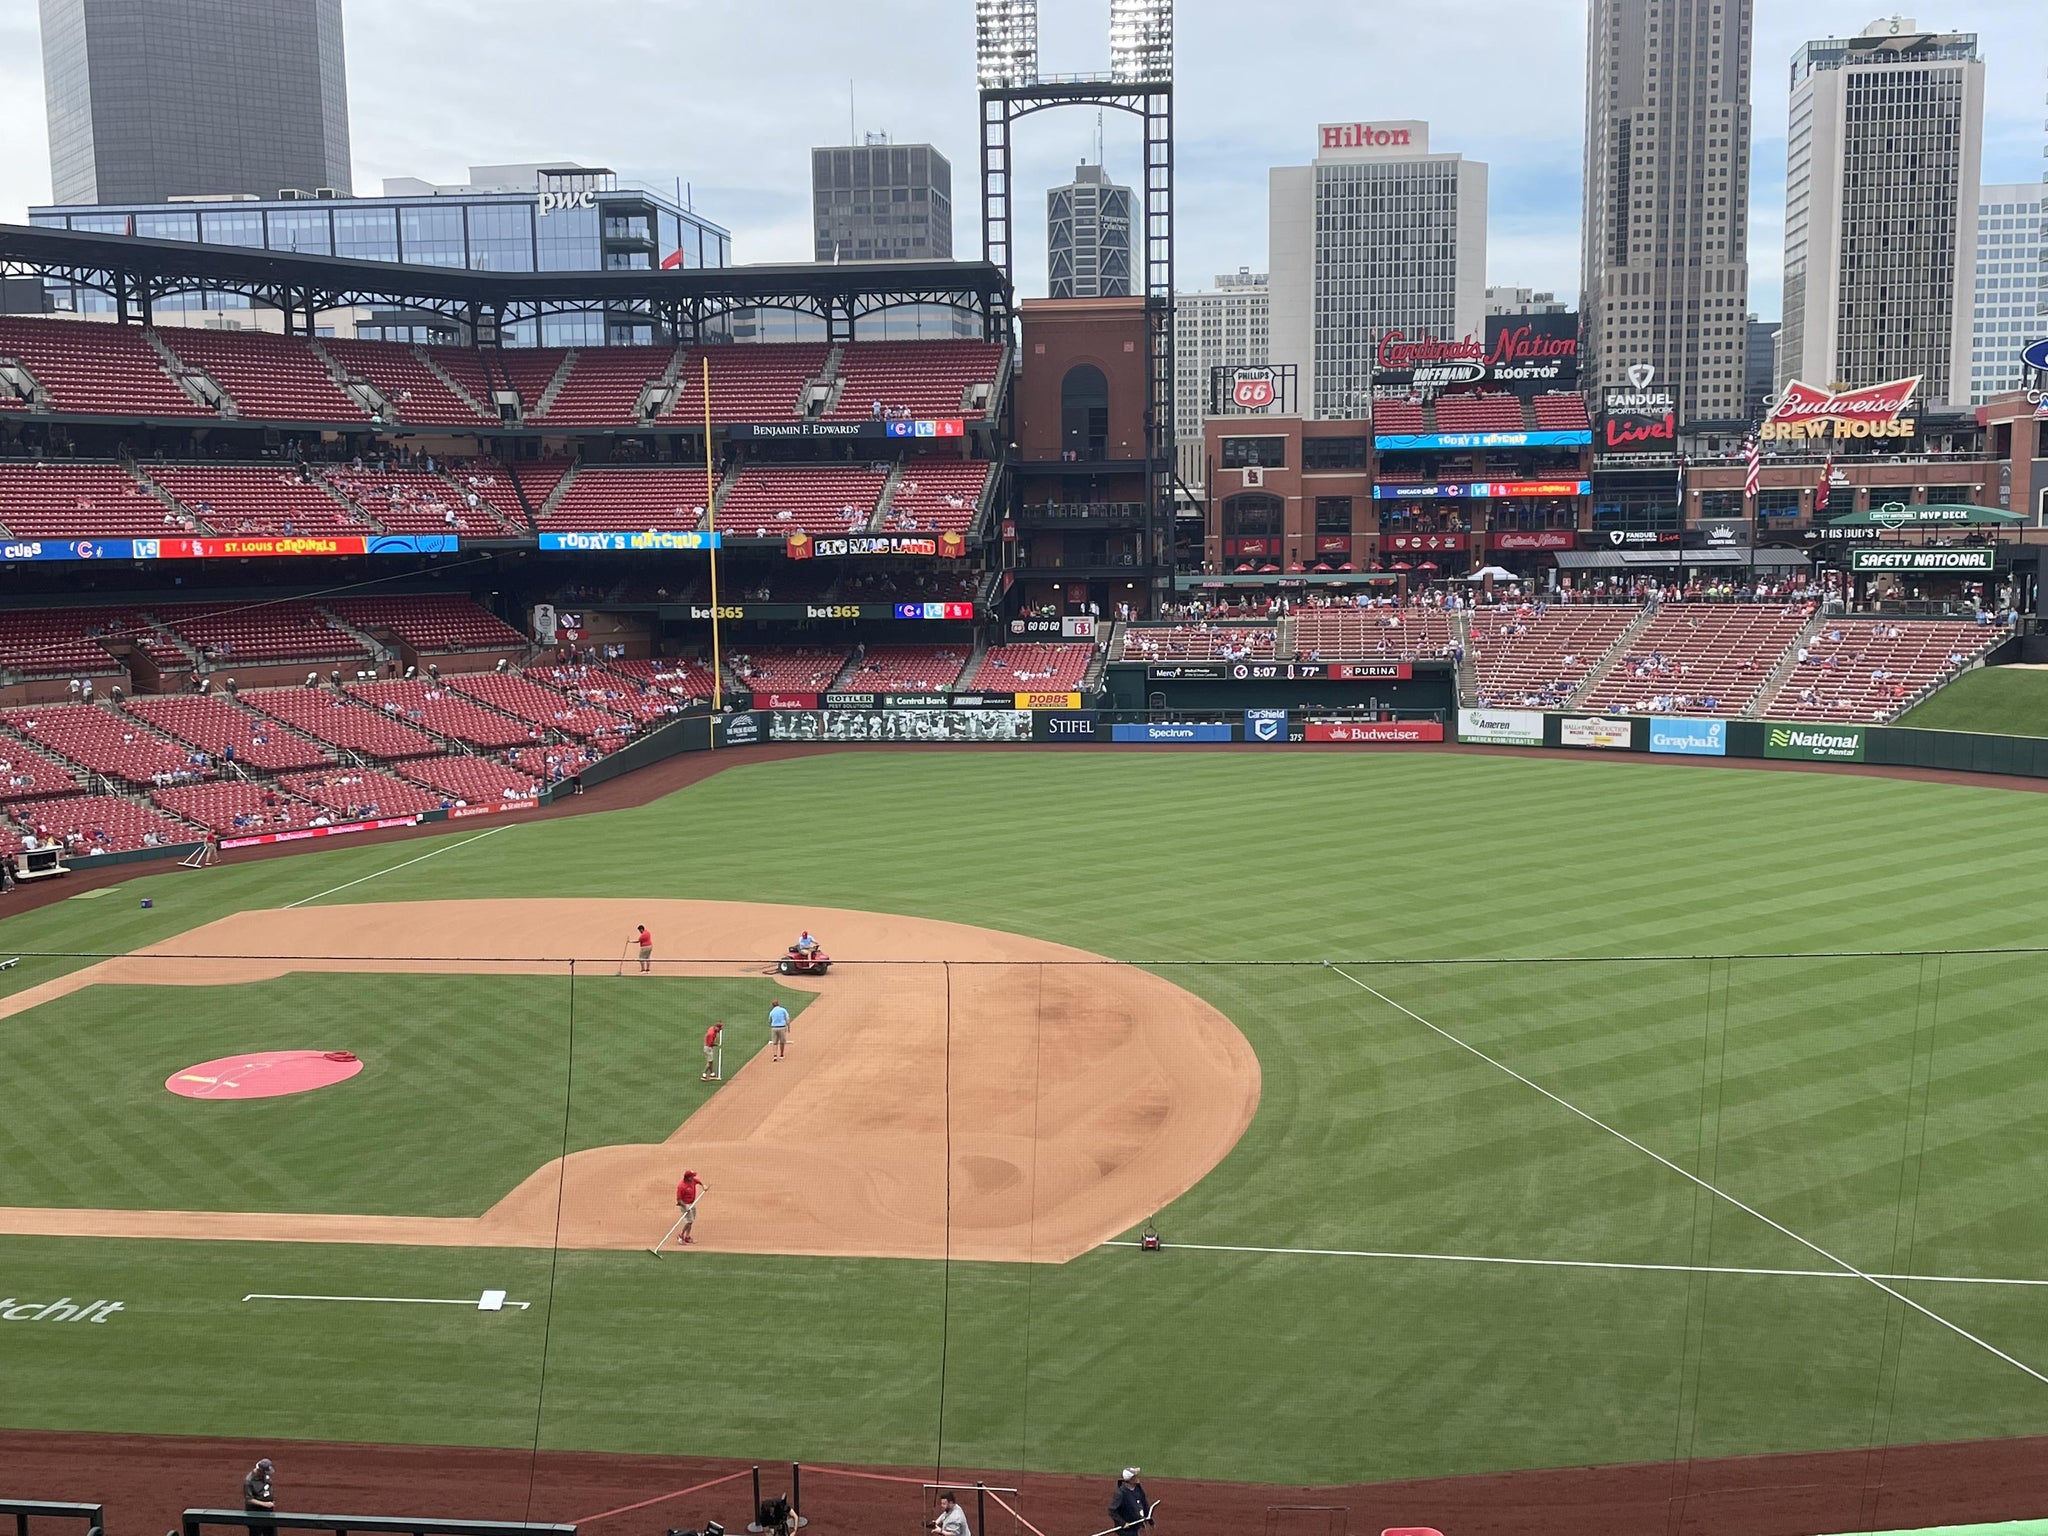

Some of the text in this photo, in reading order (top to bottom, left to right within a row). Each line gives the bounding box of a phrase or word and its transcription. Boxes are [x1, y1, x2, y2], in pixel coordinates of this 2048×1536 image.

[1323, 124, 1410, 148] Hilton
[537, 190, 595, 217] pwc
[1378, 327, 1576, 368] Cardinals Nation
[1238, 372, 1270, 380] PHILLIPS
[1413, 367, 1559, 381] HOFFMANN ROOFTOP
[1239, 384, 1267, 401] 66
[1608, 394, 1674, 406] FANDUEL
[1763, 393, 1914, 417] Budweiser
[753, 425, 801, 436] BENJAMIN
[803, 424, 810, 434] F.
[1607, 413, 1674, 446] Live!
[1761, 418, 1915, 440] BREW HOUSE
[1920, 510, 1968, 520] MVP DECK
[1820, 529, 1843, 539] THIS
[558, 532, 703, 549] TODAY'S MATCHUP
[5, 543, 42, 558] CUBS
[137, 541, 157, 556] VS
[225, 543, 240, 552] ST.
[242, 542, 273, 552] LOUIS
[275, 540, 337, 553] CARDINALS
[815, 538, 936, 556] BIG MAC LAND
[1859, 554, 1988, 567] SAFETY NATIONAL
[691, 607, 744, 619] bet365
[807, 605, 860, 618] bet365
[1076, 623, 1090, 634] 63
[1156, 669, 1177, 678] Mercy
[1253, 667, 1277, 677] 5:07
[1301, 667, 1320, 677] 77°
[1355, 667, 1396, 675] PURINA
[897, 697, 925, 705] Central
[1028, 694, 1068, 703] DOBBS
[1248, 710, 1285, 719] CarShield
[1049, 718, 1095, 733] STIFEL
[1479, 719, 1510, 730] Ameren
[1149, 728, 1191, 739] Spectrum
[1290, 733, 1304, 742] 375'
[1351, 728, 1419, 740] Budweiser
[1789, 732, 1859, 748] National
[328, 824, 365, 835] Budweiser
[276, 831, 314, 841] Budweiser
[220, 837, 262, 849] Budweiser
